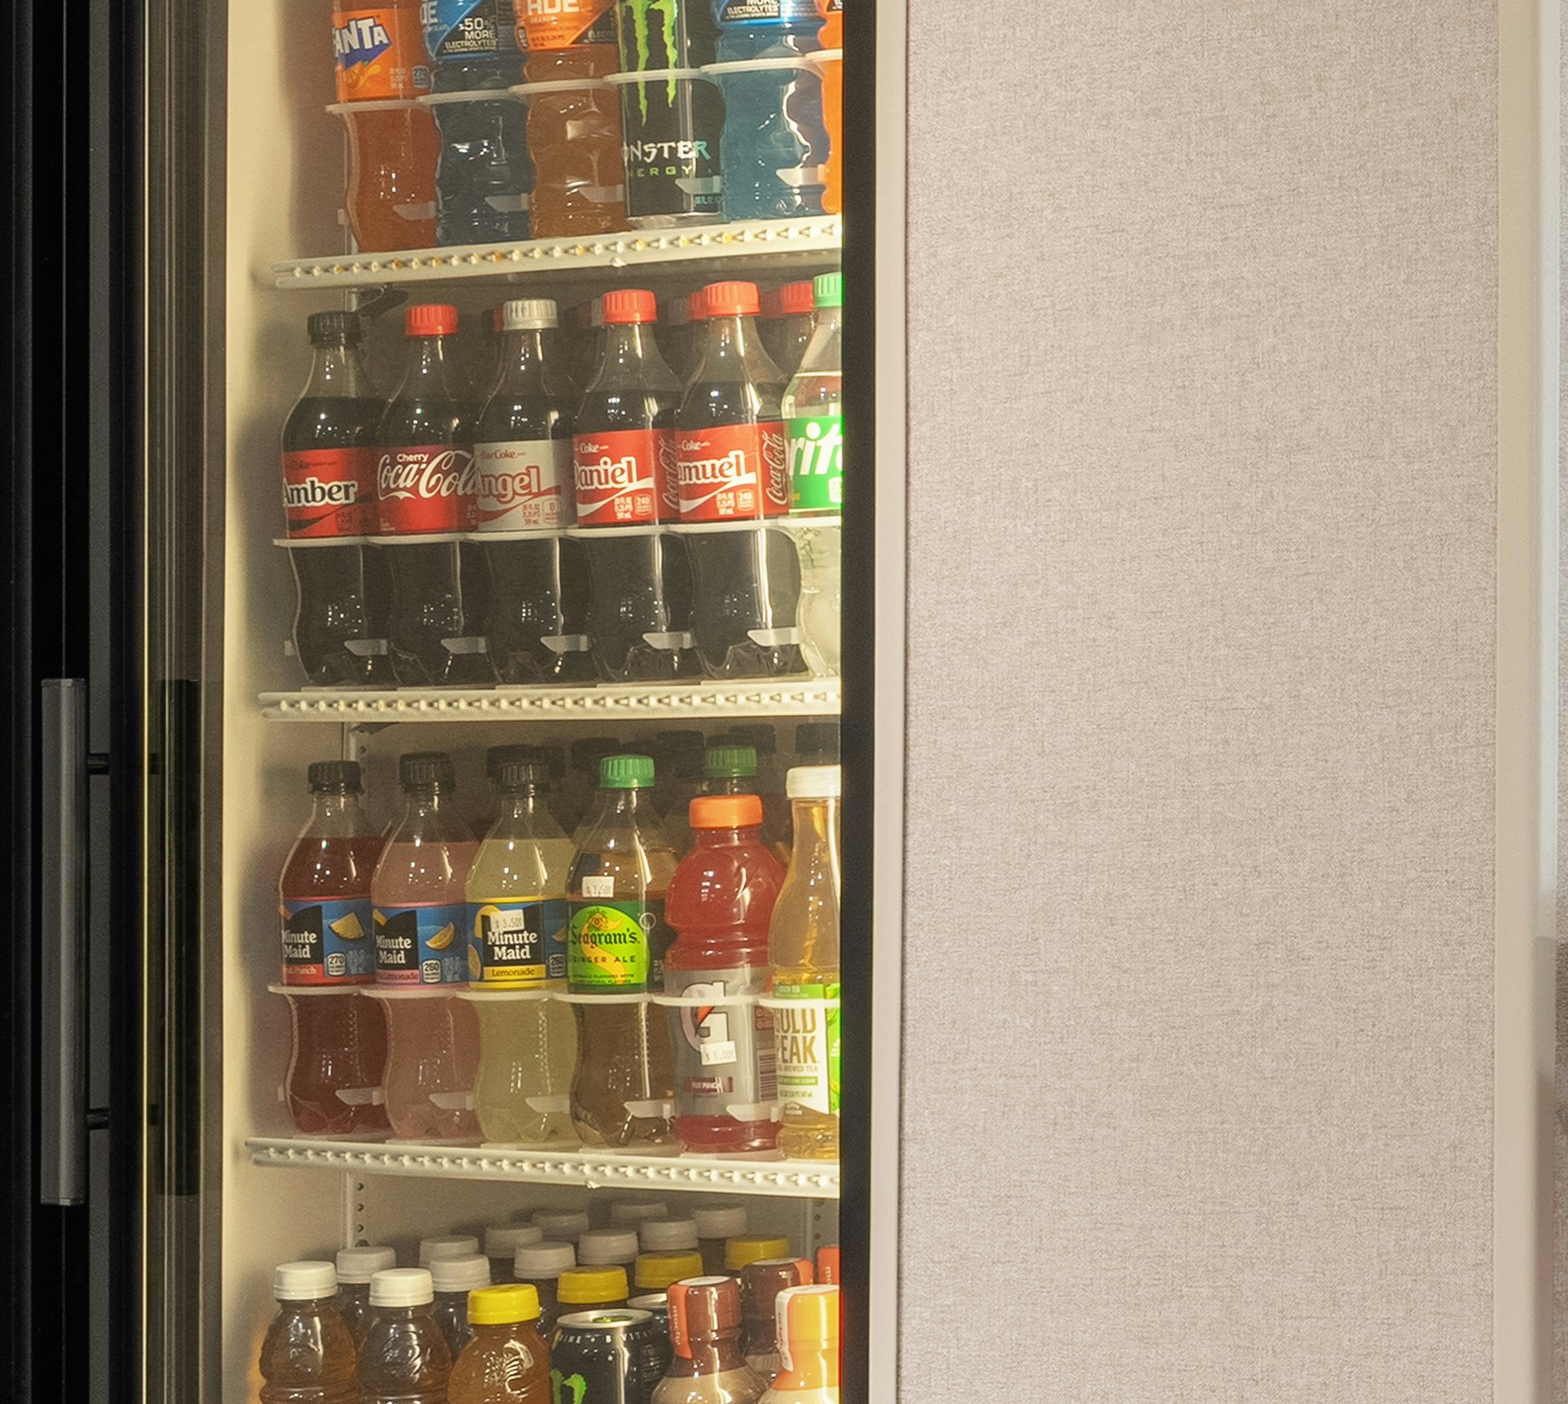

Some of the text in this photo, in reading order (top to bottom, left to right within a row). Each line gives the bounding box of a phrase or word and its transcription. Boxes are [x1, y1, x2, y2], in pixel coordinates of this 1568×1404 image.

[465, 30, 496, 40] MORE
[397, 453, 428, 463] Cherry
[376, 935, 412, 949] Minute
[487, 930, 538, 945] Minute
[379, 950, 406, 964] Maid
[493, 945, 531, 960] Maid
[614, 955, 636, 963] ALE
[492, 968, 535, 977] Lemonade
